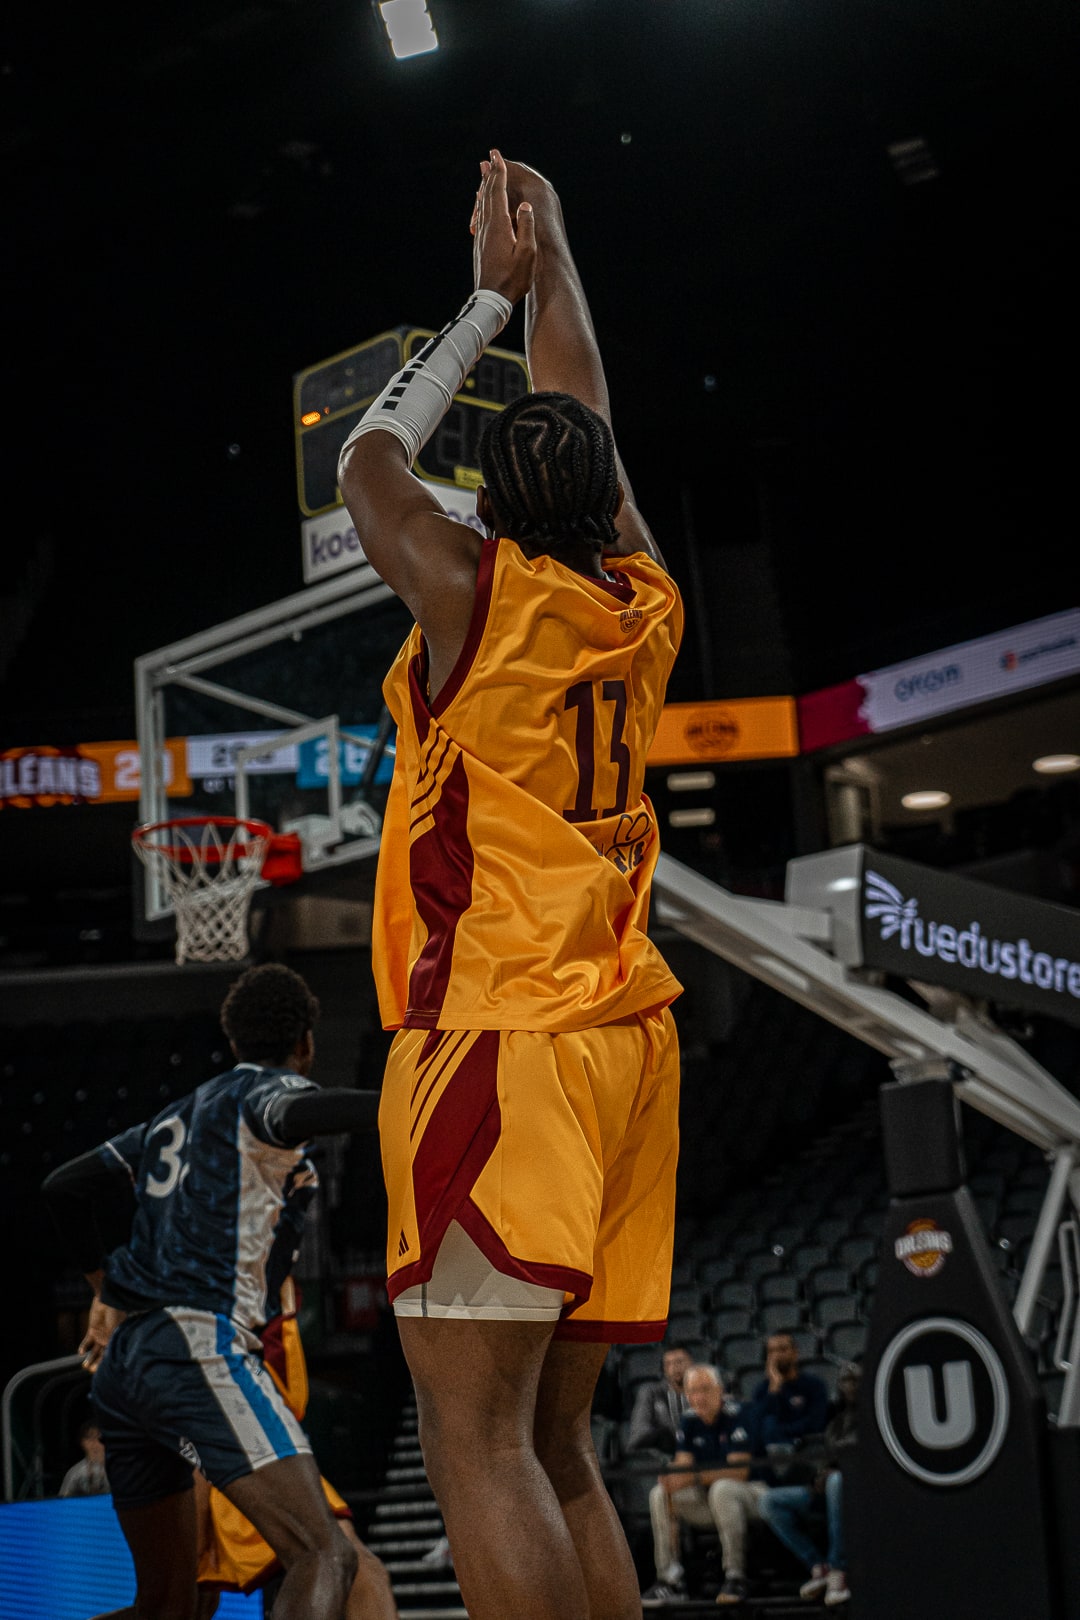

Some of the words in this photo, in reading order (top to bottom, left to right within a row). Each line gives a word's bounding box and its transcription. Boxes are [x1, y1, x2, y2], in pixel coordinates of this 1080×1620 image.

[0, 753, 100, 798] LÉANS
[563, 680, 630, 824] 13
[904, 1360, 976, 1450] U
